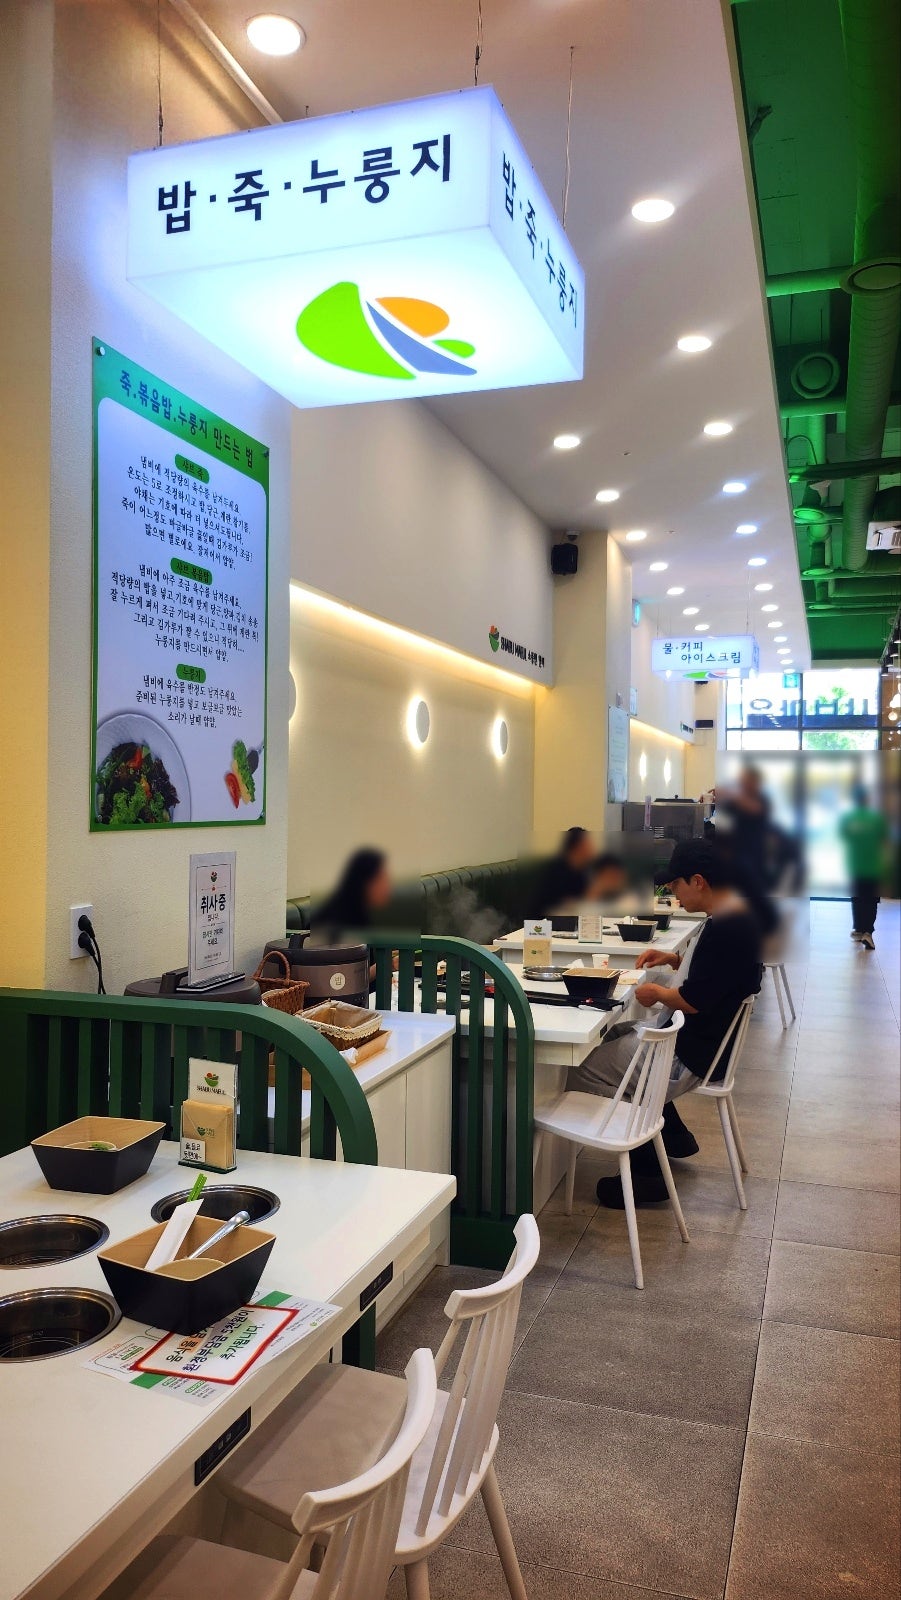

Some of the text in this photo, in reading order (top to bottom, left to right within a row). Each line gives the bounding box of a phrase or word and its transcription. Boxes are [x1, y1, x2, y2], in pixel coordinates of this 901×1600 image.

[158, 134, 452, 234] 밥·죽·누룽지
[213, 427, 240, 460] 만드는
[245, 446, 253, 469] 법
[140, 455, 161, 475] 냄비에
[164, 467, 189, 489] 적당량의
[181, 459, 204, 480] 샤브 죽
[127, 465, 149, 486] 온도는
[150, 477, 162, 491] 5로
[165, 484, 196, 506] 조정하시고
[133, 486, 155, 505] 야채는
[157, 497, 177, 516] 기호에
[179, 506, 192, 521] 따라
[194, 513, 201, 526] 더
[121, 496, 136, 514] 죽이
[138, 505, 166, 524] 어느정도
[216, 538, 238, 556] 김가루가
[138, 564, 159, 581] 냄비에
[161, 571, 175, 586] 아주
[177, 577, 190, 592] 조금
[192, 582, 210, 598] 육수를
[175, 561, 209, 583] 샤브 볶음밥
[111, 571, 141, 591] 적당량의
[143, 581, 157, 597] 밥을
[195, 598, 208, 610] 맞게
[110, 587, 118, 602] 잘
[161, 603, 175, 618] 조금
[177, 608, 196, 624] 기다려
[218, 621, 225, 631] 그
[239, 626, 250, 639] 계란
[133, 612, 154, 627] 그리고
[157, 618, 183, 636] 김가루가
[193, 628, 200, 640] 수
[155, 633, 181, 650] 누룽지를
[183, 640, 212, 657] 만드시면서
[681, 652, 741, 664] 아이스크림
[143, 674, 163, 689] 냄비에
[166, 678, 185, 693] 육수를
[187, 682, 205, 696] 반정도
[182, 666, 201, 681] 누룽지
[135, 690, 242, 717] 준비된 누룽지를 넣고 보글보글 맛있는
[167, 711, 187, 724] 소리가
[188, 713, 201, 725] 날때
[201, 893, 226, 914] 취사중
[335, 977, 342, 986] 밥
[166, 1339, 199, 1363] 음식을
[181, 1333, 229, 1372] 환경부담금
[221, 1310, 254, 1334] 5천원이
